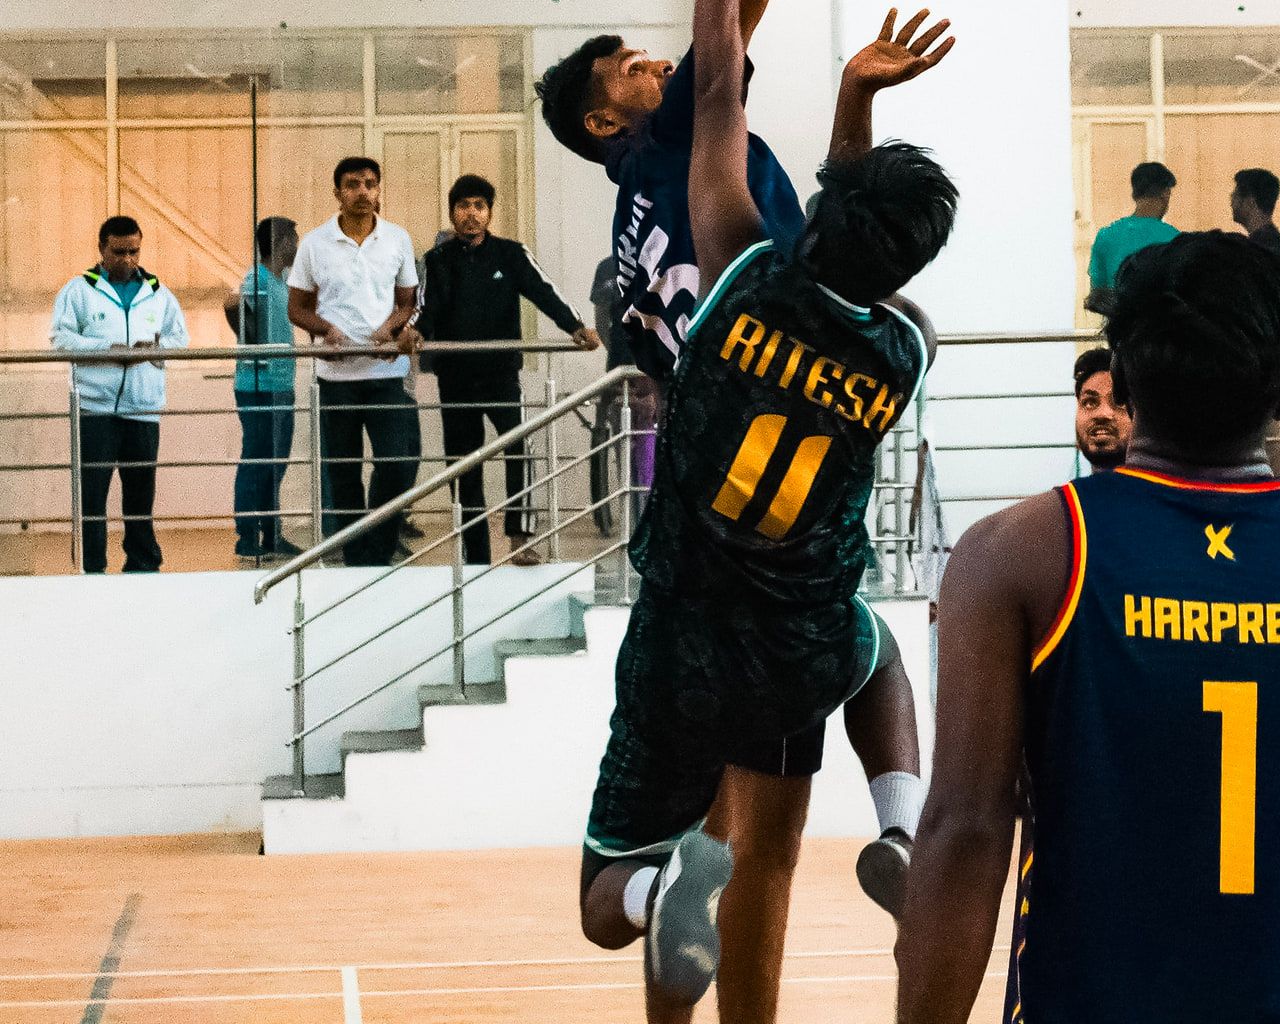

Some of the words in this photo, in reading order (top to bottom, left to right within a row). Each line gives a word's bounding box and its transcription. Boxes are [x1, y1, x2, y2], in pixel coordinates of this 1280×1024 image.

[720, 313, 904, 433] RITESH
[711, 414, 833, 538] 11
[1202, 680, 1258, 895] 1
